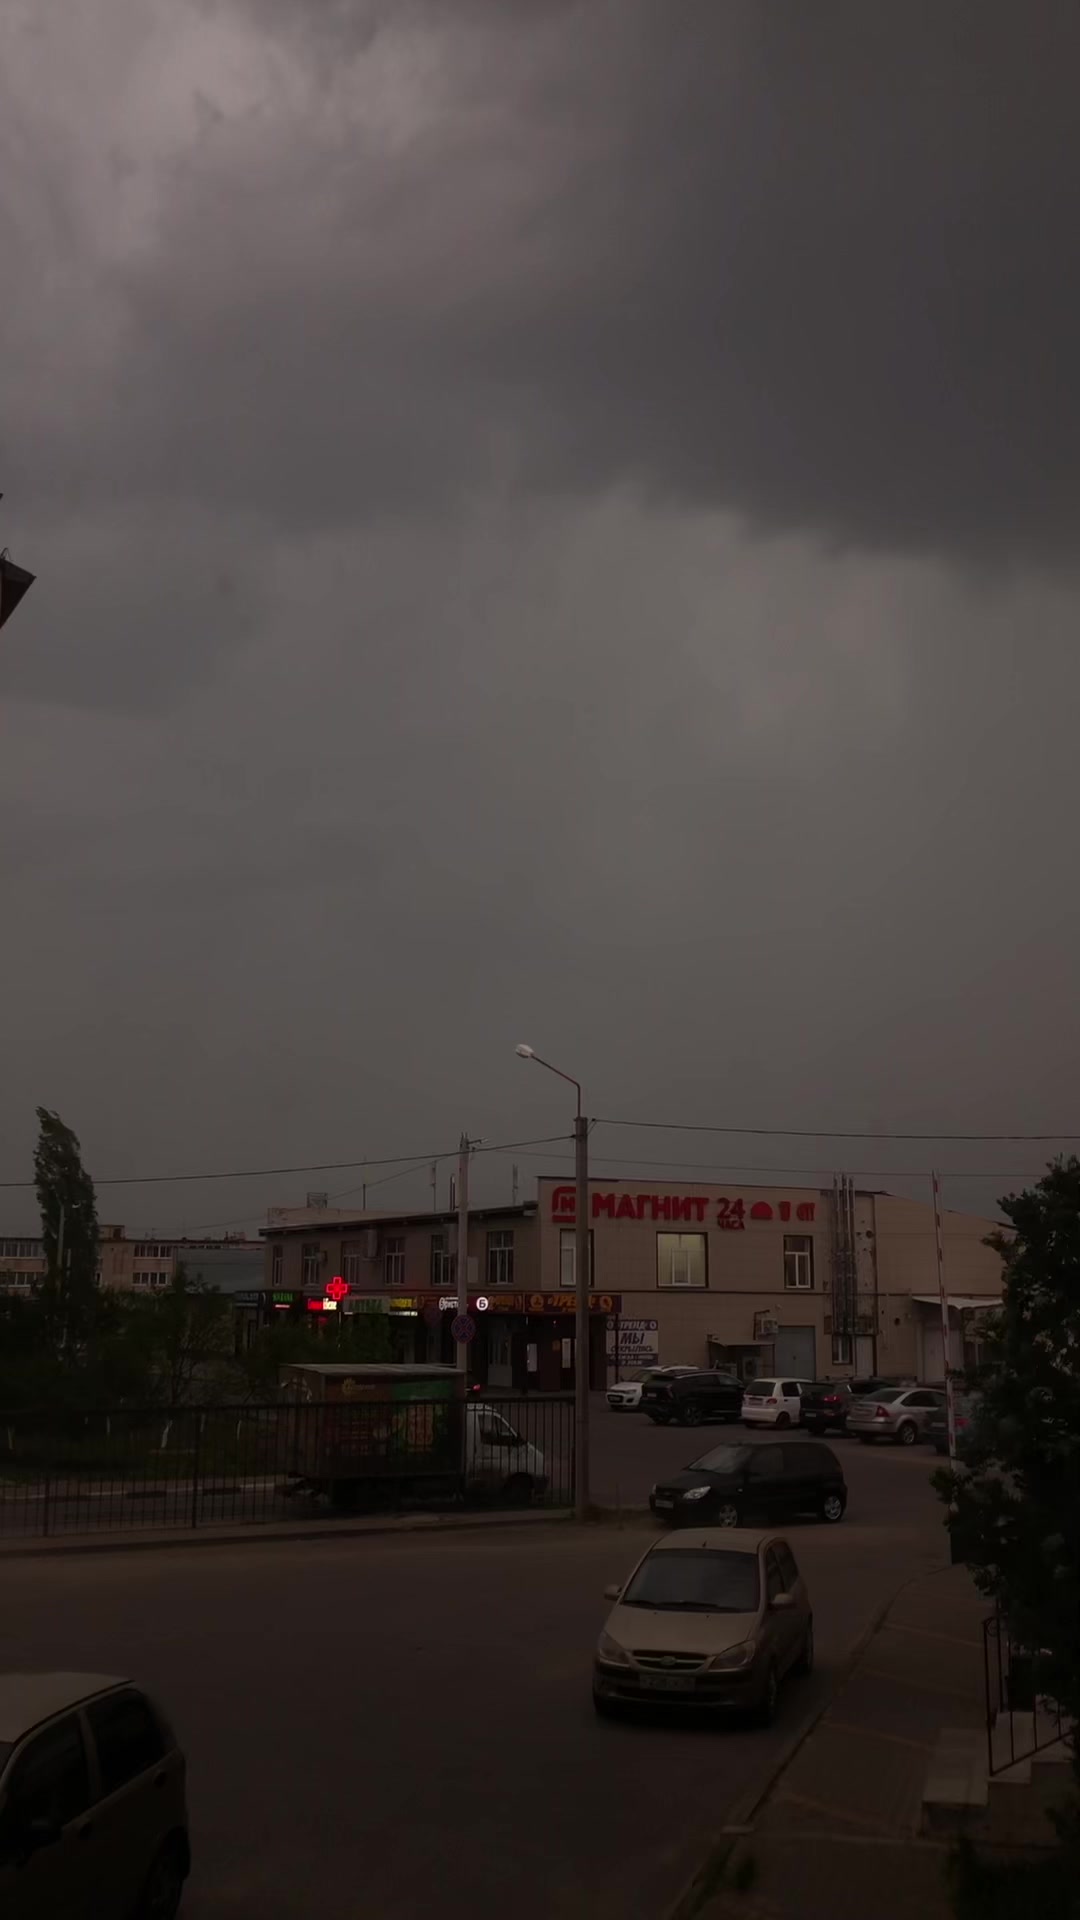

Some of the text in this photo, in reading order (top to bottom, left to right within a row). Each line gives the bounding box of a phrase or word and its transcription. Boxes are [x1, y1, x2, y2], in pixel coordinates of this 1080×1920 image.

[592, 1193, 709, 1222] МАГНИТ
[716, 1198, 746, 1219] 24
[717, 1219, 746, 1231] ЧАСА
[620, 1332, 645, 1345] МЫ
